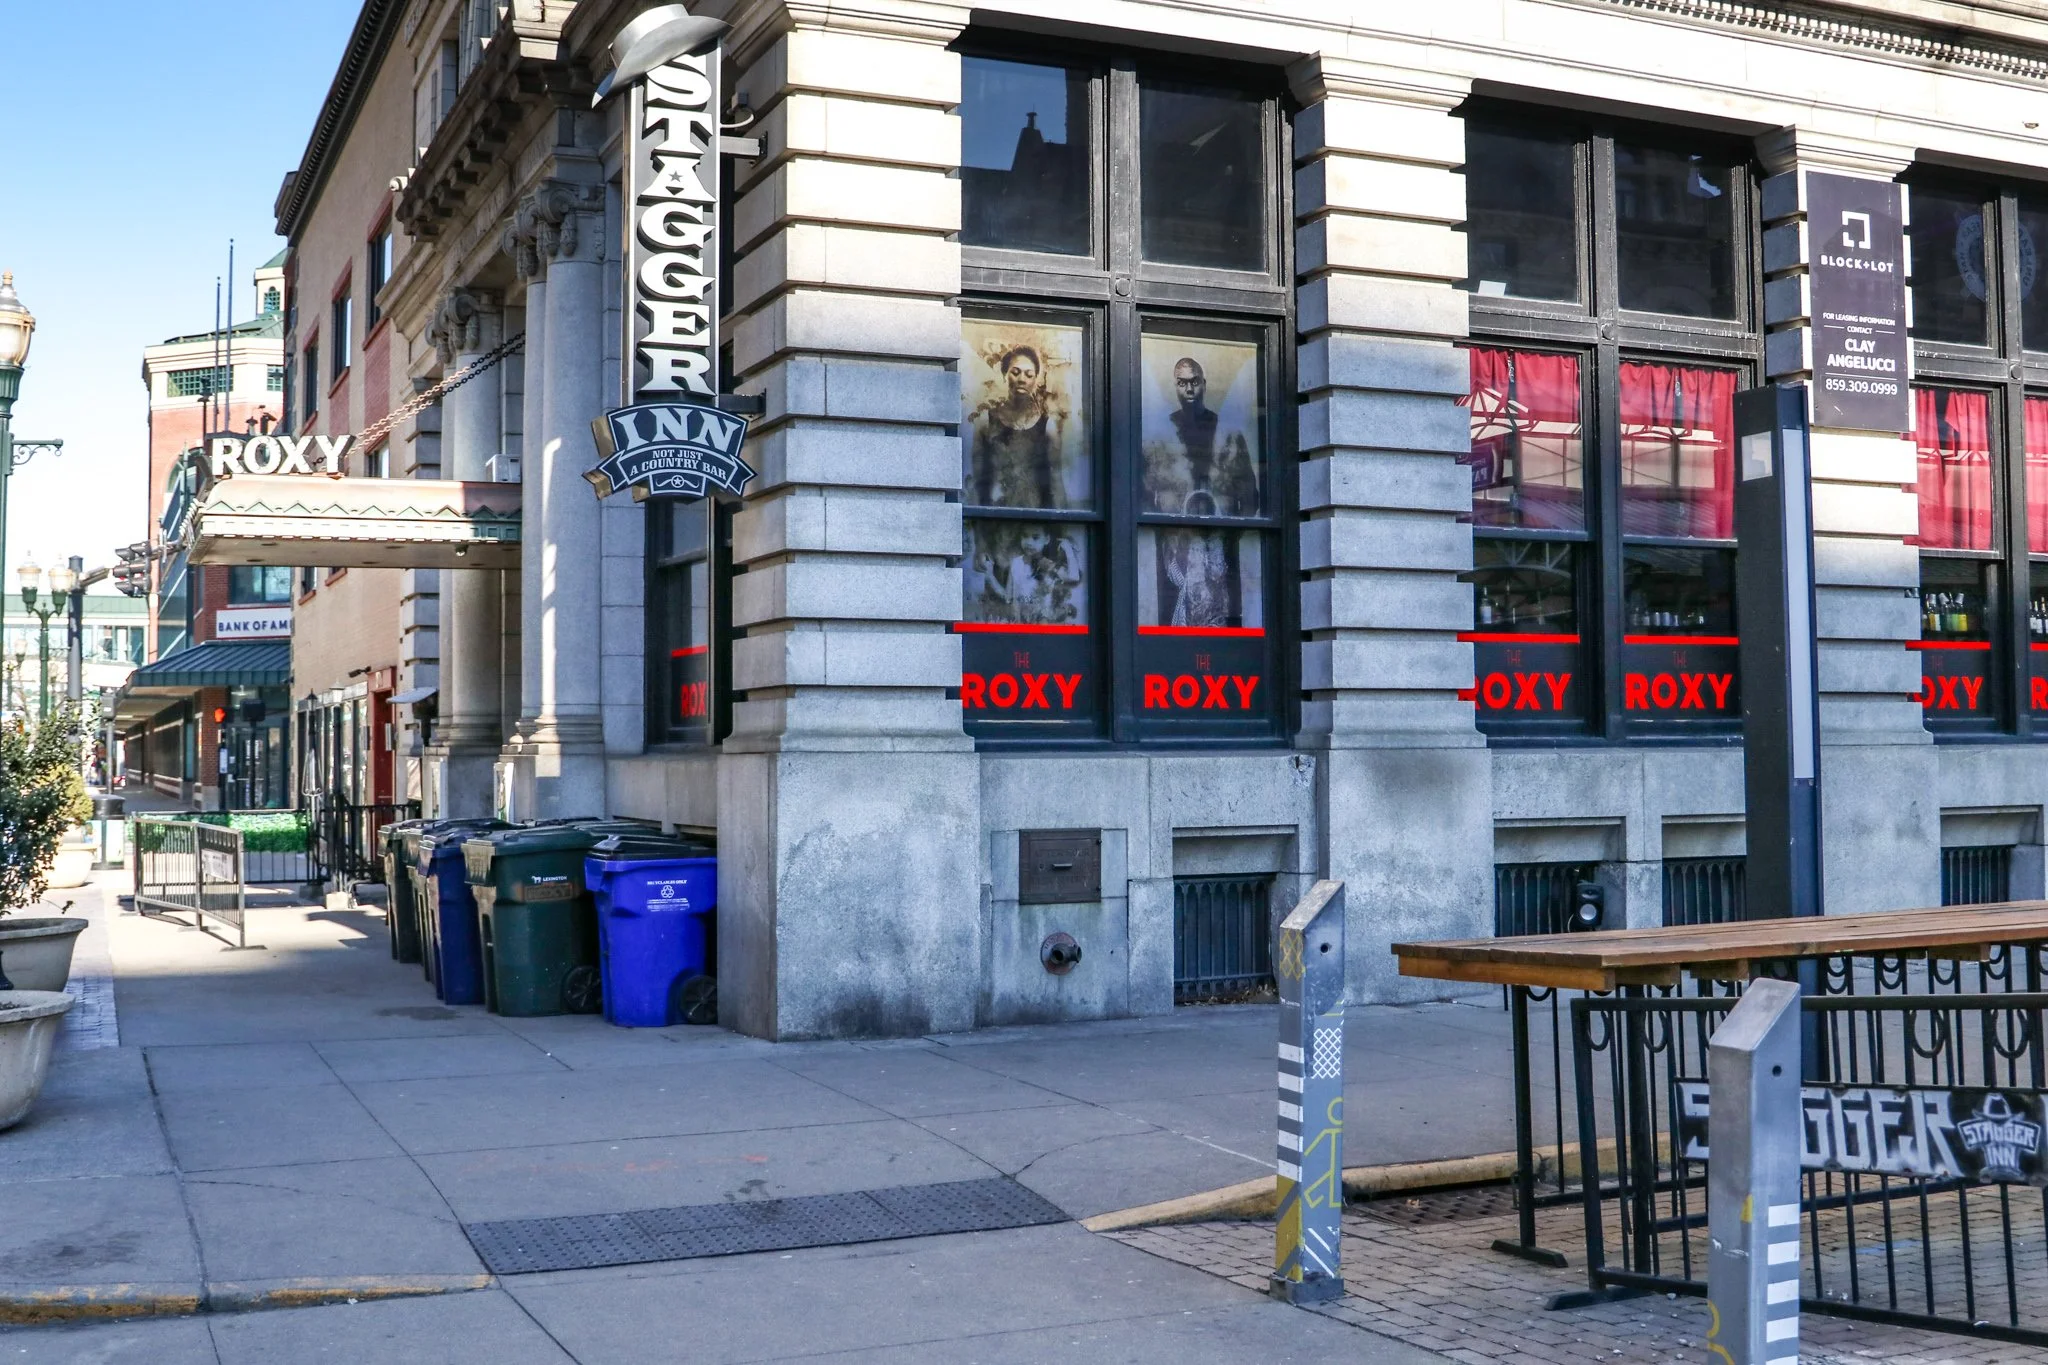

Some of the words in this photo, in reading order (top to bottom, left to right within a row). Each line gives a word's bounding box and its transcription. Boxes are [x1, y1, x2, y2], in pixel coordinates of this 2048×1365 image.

[637, 54, 717, 397] STAGGER
[1820, 254, 1894, 273] BLOCK+LOT
[1822, 312, 1835, 320] FOR
[1836, 313, 1858, 322] LEASING
[1859, 315, 1895, 326] INFORMATION
[1847, 326, 1872, 335] CONTACT
[1844, 338, 1876, 354] CLAY
[1826, 353, 1896, 372] ANGELUCCI
[1825, 378, 1898, 396] 859.309.0999
[614, 407, 741, 452] INN
[212, 434, 351, 476] ROXY
[652, 449, 675, 459] NOT
[677, 450, 703, 461] JUST
[629, 465, 638, 477] A
[641, 457, 699, 471] COUNTRY
[703, 461, 727, 480] BAR
[218, 621, 249, 632] BANK
[252, 620, 267, 631] OF
[1014, 652, 1030, 668] THE
[1196, 654, 1211, 670] THE
[960, 673, 1082, 709] ROXY
[1144, 674, 1259, 709] ROXY
[1625, 673, 1733, 710] ROXY
[1912, 675, 1984, 709] OXY
[1986, 1145, 2017, 1169] INN
